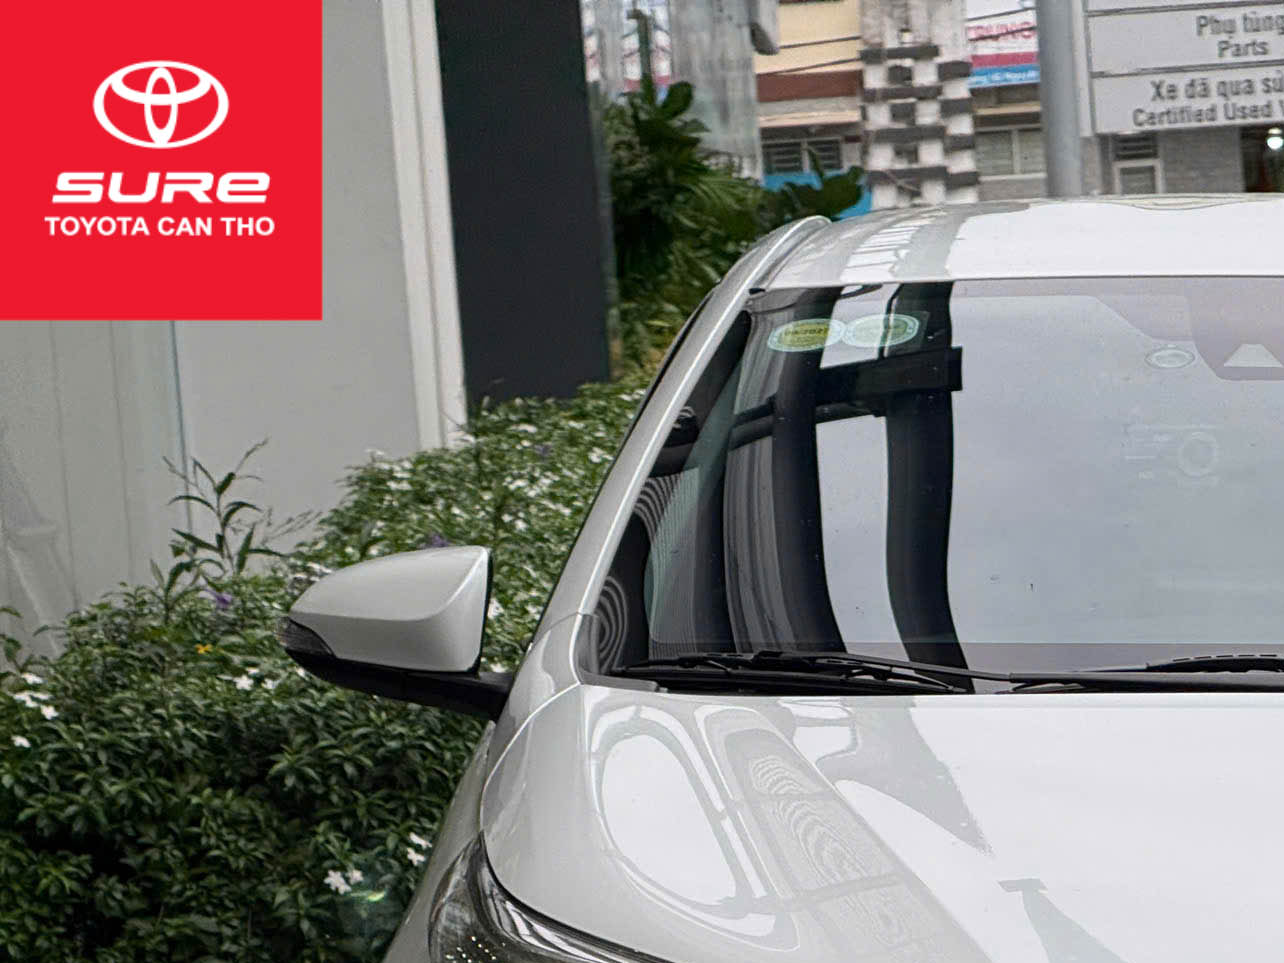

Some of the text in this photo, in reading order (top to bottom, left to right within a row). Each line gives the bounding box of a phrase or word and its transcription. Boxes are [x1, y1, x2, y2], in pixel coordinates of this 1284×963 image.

[1217, 40, 1269, 57] Parts
[1150, 80, 1178, 102] Xe
[1217, 78, 1255, 102] qua
[1133, 103, 1218, 127] Certified
[1223, 100, 1274, 121] Used
